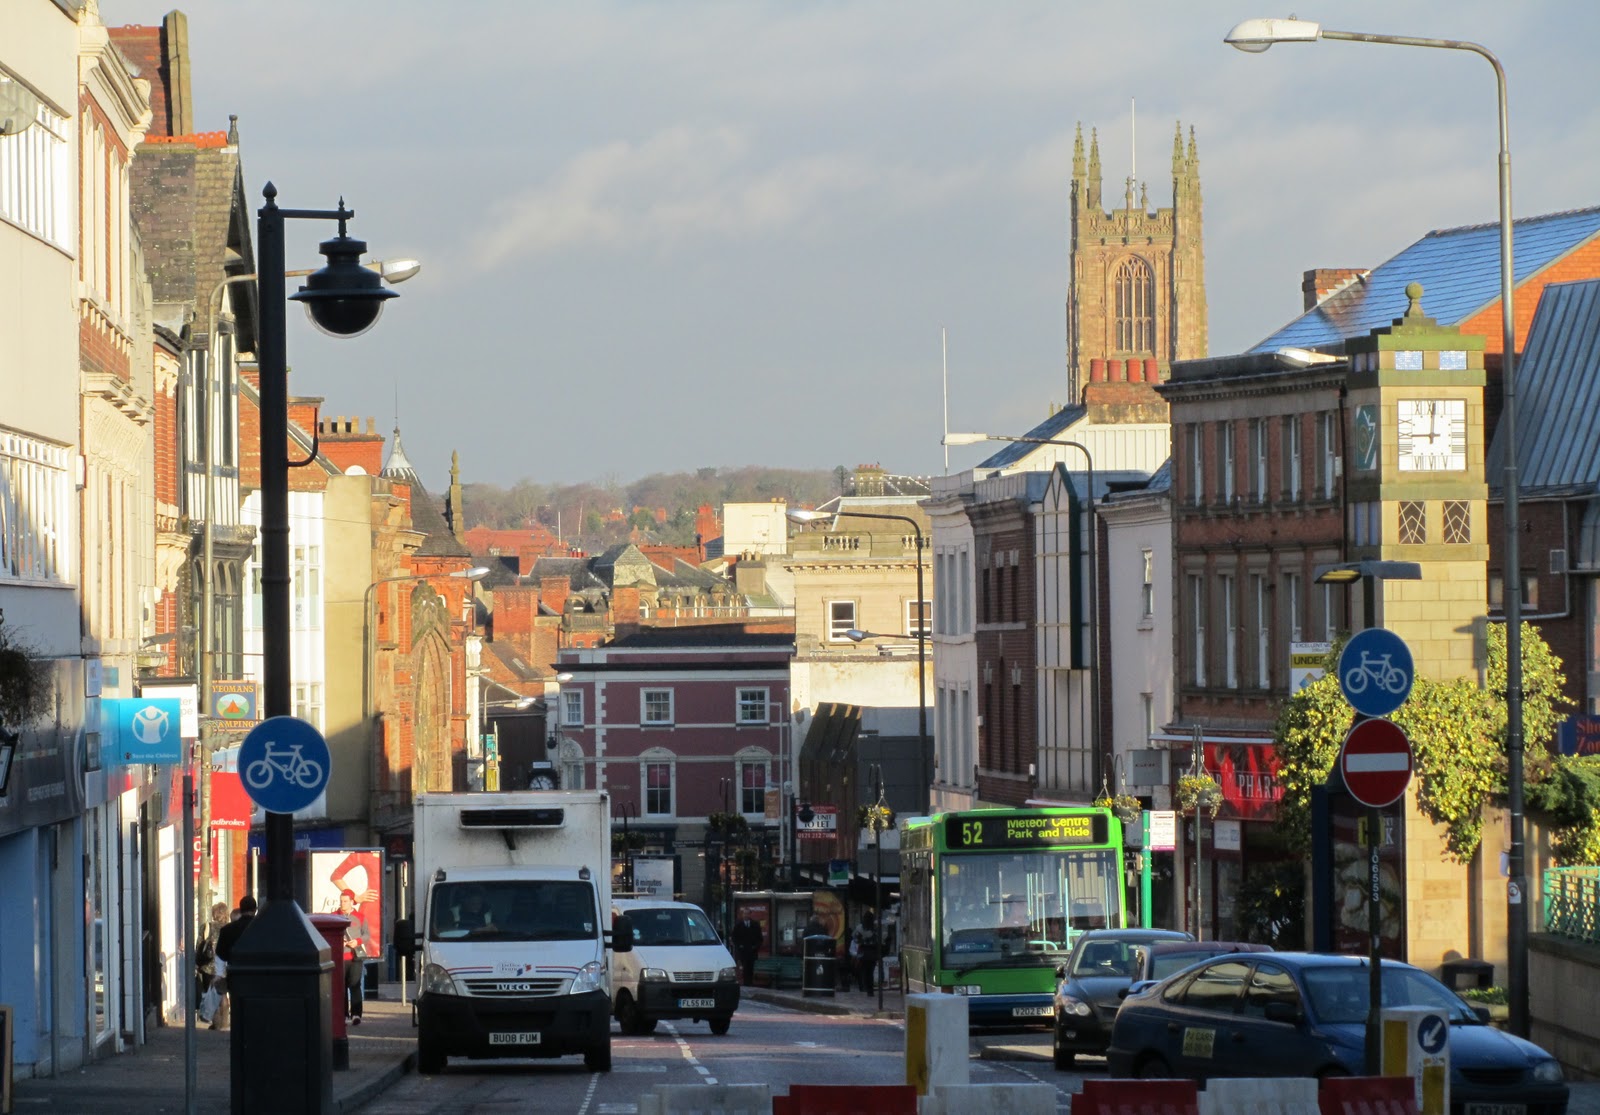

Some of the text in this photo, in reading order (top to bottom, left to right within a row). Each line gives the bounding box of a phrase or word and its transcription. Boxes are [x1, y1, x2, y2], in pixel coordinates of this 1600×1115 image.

[212, 685, 254, 693] YEOMANS
[213, 720, 254, 728] AMPING
[1007, 817, 1090, 828] Meteor Centre
[963, 821, 983, 845] 52
[1007, 827, 1090, 839] Park and Ride
[682, 999, 714, 1007] FL55 RXC
[1015, 1007, 1035, 1016] V202
[493, 1033, 538, 1043] BU08 FUM
